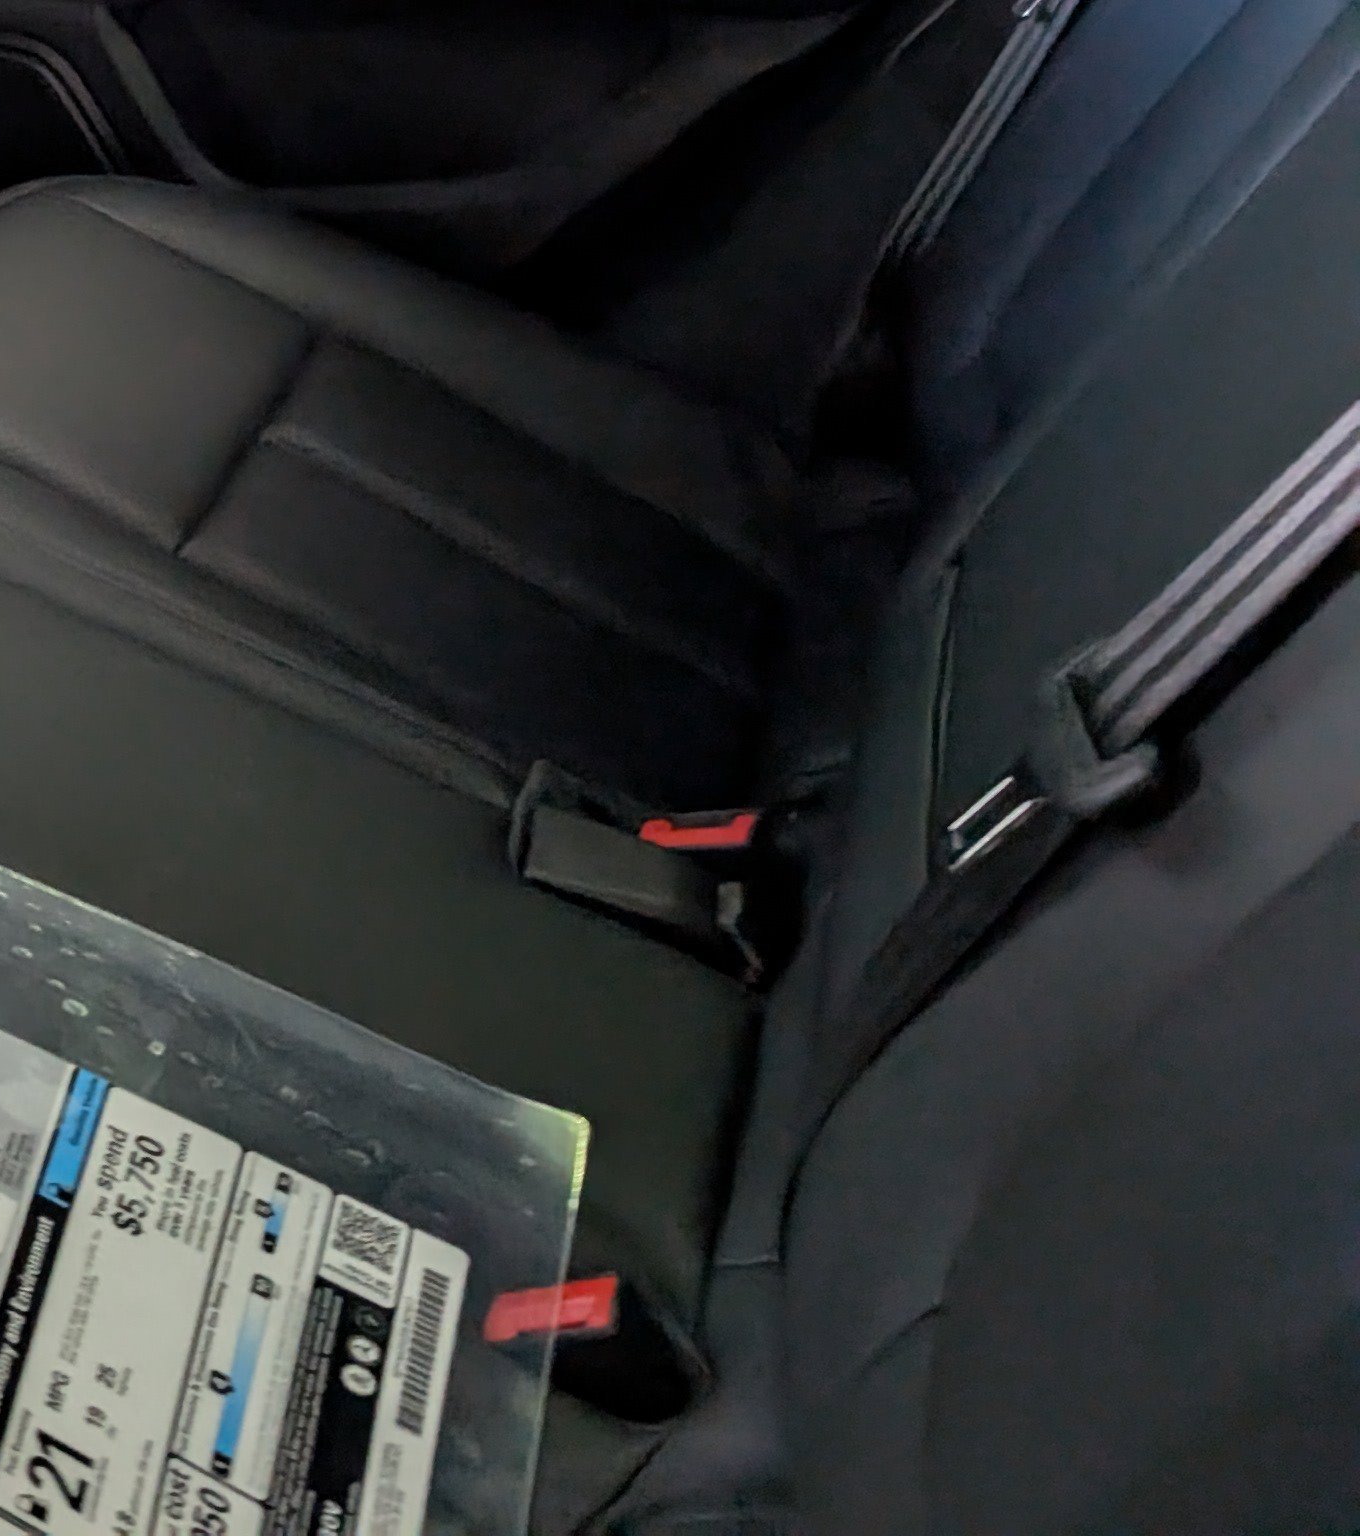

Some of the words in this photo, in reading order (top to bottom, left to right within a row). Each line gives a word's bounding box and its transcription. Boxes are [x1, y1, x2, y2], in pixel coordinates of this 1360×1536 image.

[95, 1126, 128, 1189] spend
[113, 1135, 165, 1236] $5,750
[91, 1194, 109, 1218] You
[9, 1216, 53, 1310] Environment
[0, 1309, 24, 1343] and
[44, 1371, 69, 1410] MPG
[27, 1428, 95, 1512] 21
